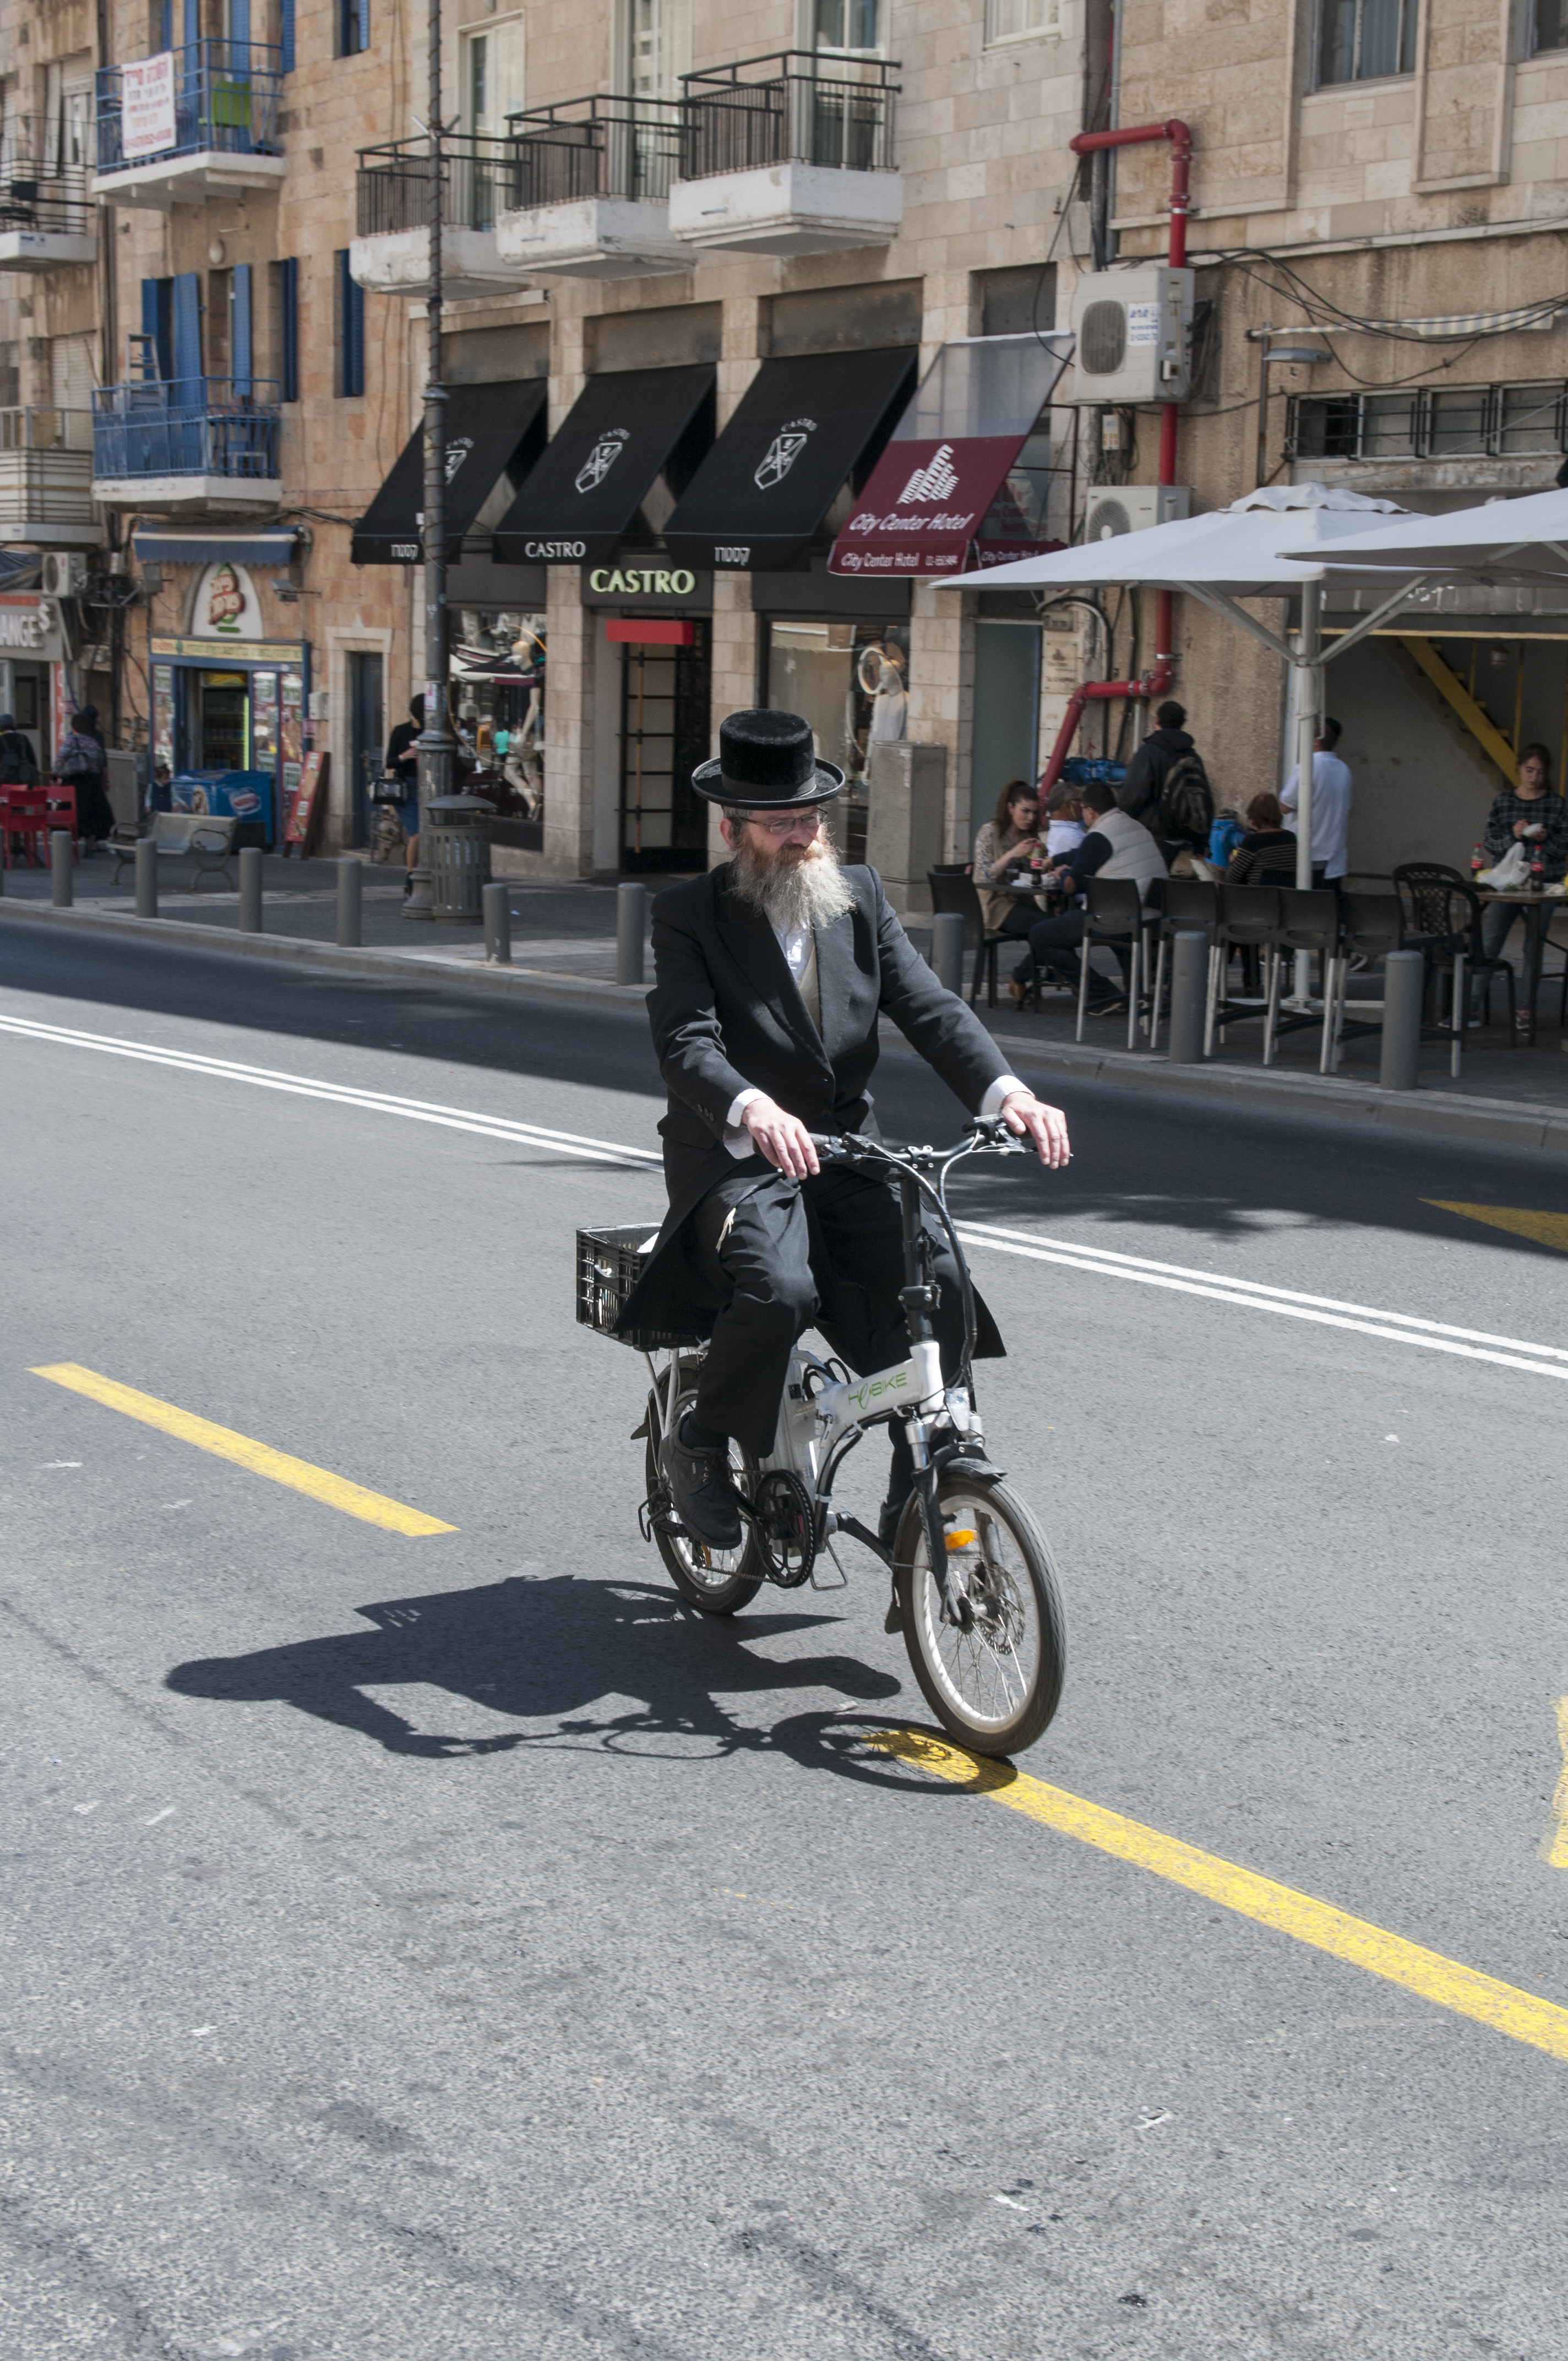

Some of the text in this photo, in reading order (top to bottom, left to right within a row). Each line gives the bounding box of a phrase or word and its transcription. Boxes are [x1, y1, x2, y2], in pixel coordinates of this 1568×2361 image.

[849, 513, 882, 536] City
[879, 513, 930, 530] Center
[926, 513, 975, 530] Hotel
[525, 542, 586, 557] CASTRO
[715, 547, 750, 565] קסטרו
[841, 552, 863, 571] City
[863, 552, 894, 567] Center
[894, 552, 920, 567] Hotel
[590, 569, 695, 594] CASTRO
